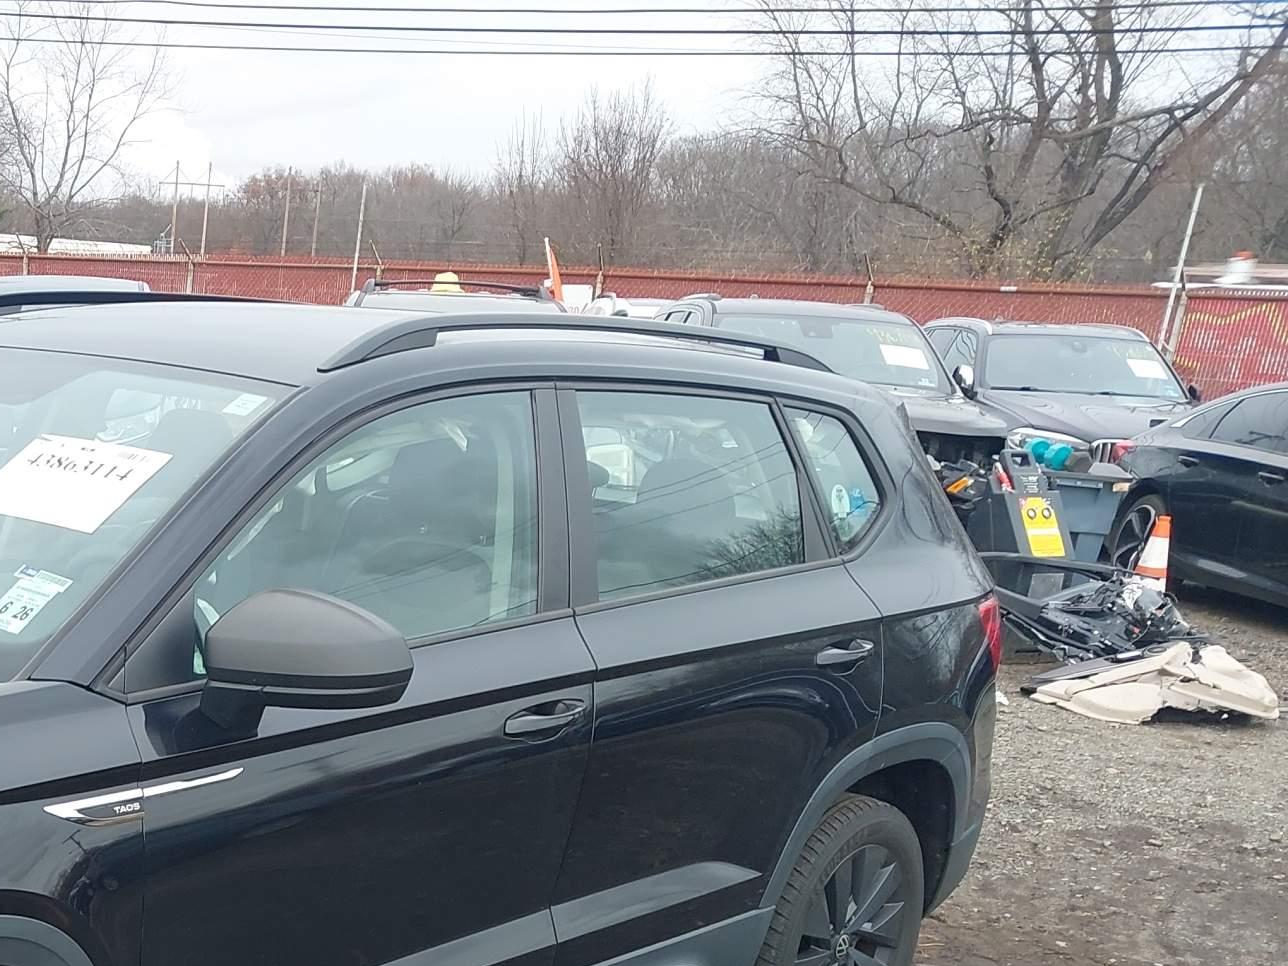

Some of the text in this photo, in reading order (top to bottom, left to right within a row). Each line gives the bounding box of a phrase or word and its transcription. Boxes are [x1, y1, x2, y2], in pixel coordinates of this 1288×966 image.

[26, 453, 134, 482] 43863114
[0, 601, 14, 615] 6
[11, 605, 35, 621] 26
[113, 802, 141, 815] TAOS
